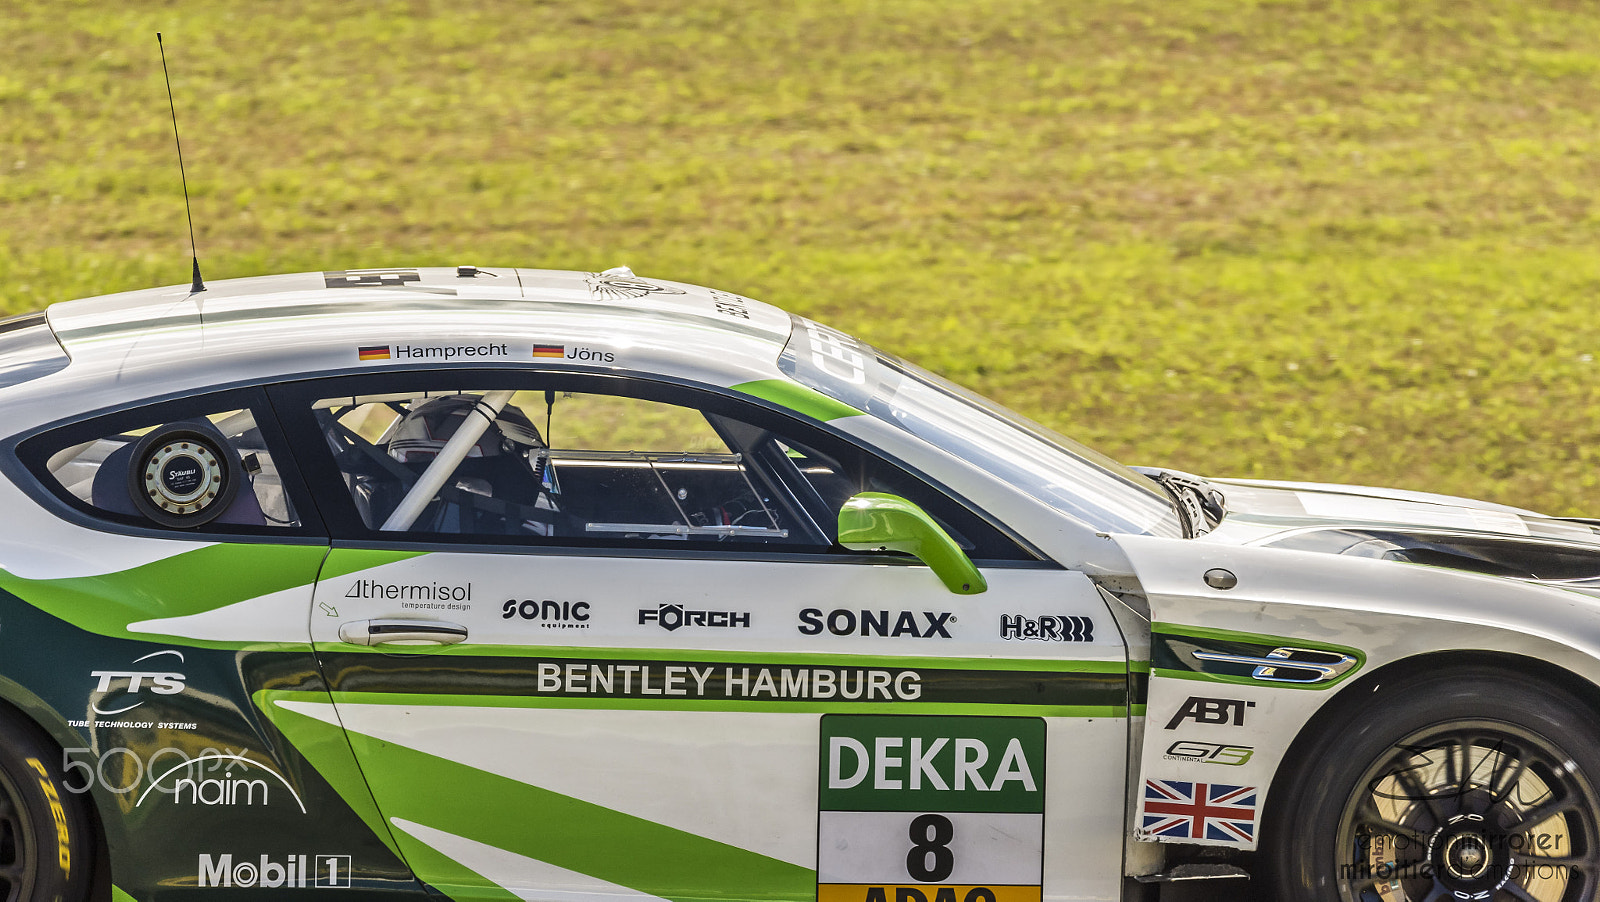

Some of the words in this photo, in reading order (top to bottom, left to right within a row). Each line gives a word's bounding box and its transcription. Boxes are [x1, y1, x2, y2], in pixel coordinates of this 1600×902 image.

[396, 343, 508, 360] Hamprecht
[566, 347, 615, 363] Jöns
[401, 602, 446, 611] temperature
[447, 603, 471, 611] design
[541, 622, 590, 630] equipment
[1000, 614, 1063, 641] H&R
[90, 670, 187, 695] TTS
[537, 662, 715, 696] BENTLEY
[725, 667, 922, 700] HAMBURG
[67, 720, 90, 728] TUBE
[94, 720, 154, 729] TECHNOLOGY
[157, 722, 198, 730] SYSTEMS
[1164, 696, 1256, 730] ABT
[828, 736, 1038, 792] DEKRA
[1162, 754, 1206, 764] CONTINENTAL
[174, 771, 268, 805] naim
[906, 813, 955, 882] 8
[198, 853, 307, 888] Mobil
